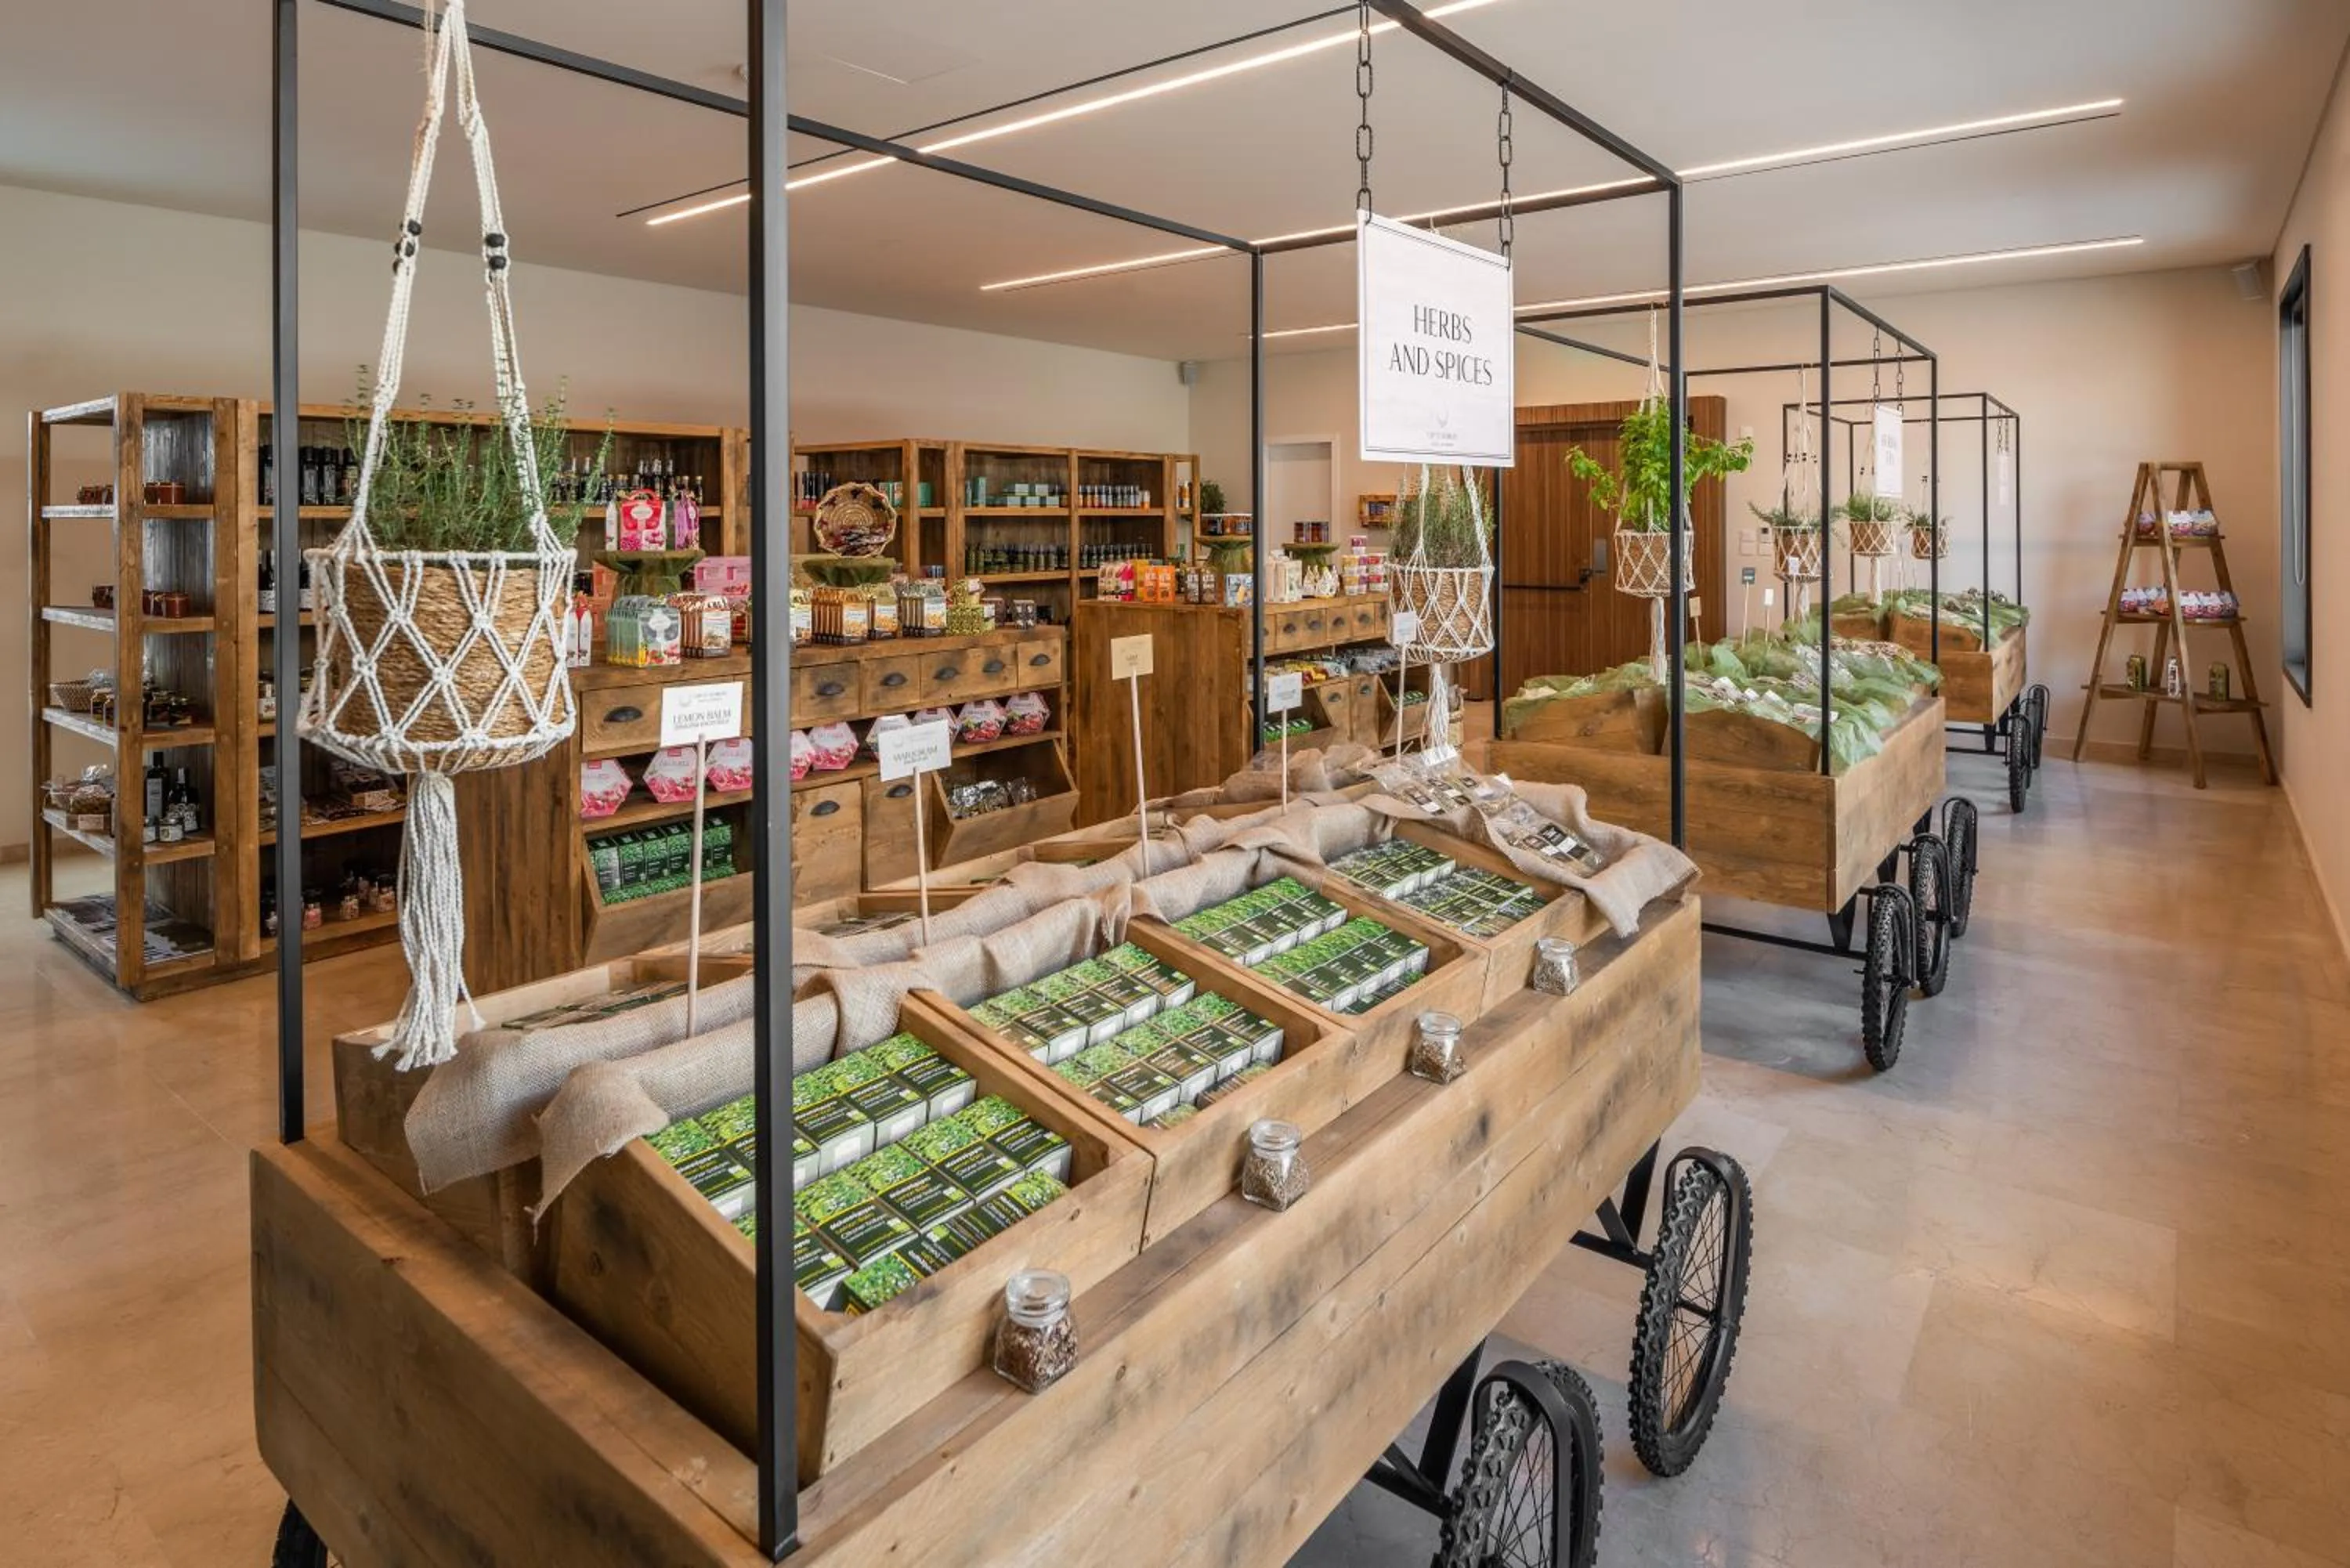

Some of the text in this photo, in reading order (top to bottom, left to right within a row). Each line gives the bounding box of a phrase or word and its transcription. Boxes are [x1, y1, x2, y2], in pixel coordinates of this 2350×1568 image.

[1414, 304, 1473, 344] HERBS
[1390, 342, 1493, 386] AND SPICES
[673, 707, 731, 724] LEMON BALM
